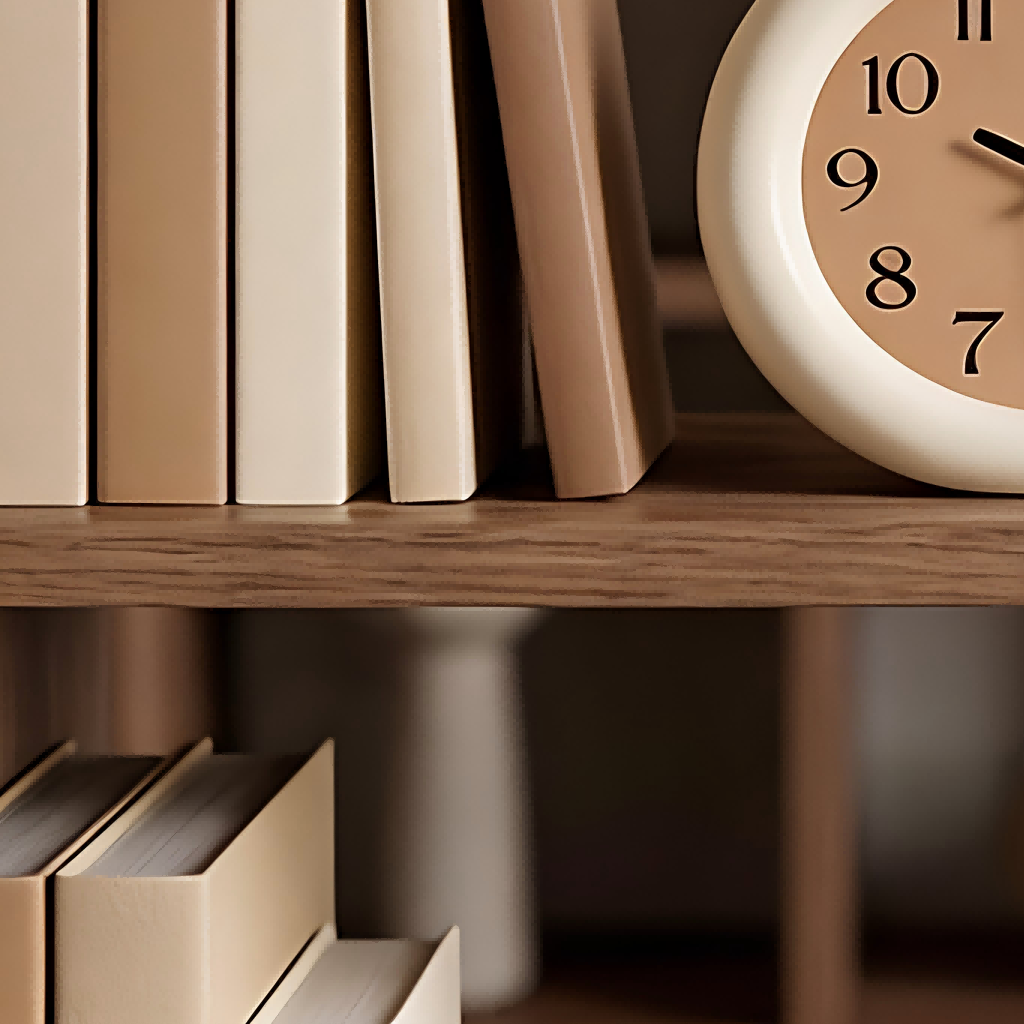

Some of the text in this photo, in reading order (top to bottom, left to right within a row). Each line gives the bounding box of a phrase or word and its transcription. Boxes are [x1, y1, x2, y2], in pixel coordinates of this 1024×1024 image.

[862, 52, 939, 115] 10
[826, 148, 879, 212] 9
[865, 245, 917, 310] 8
[952, 311, 1005, 375] 7
